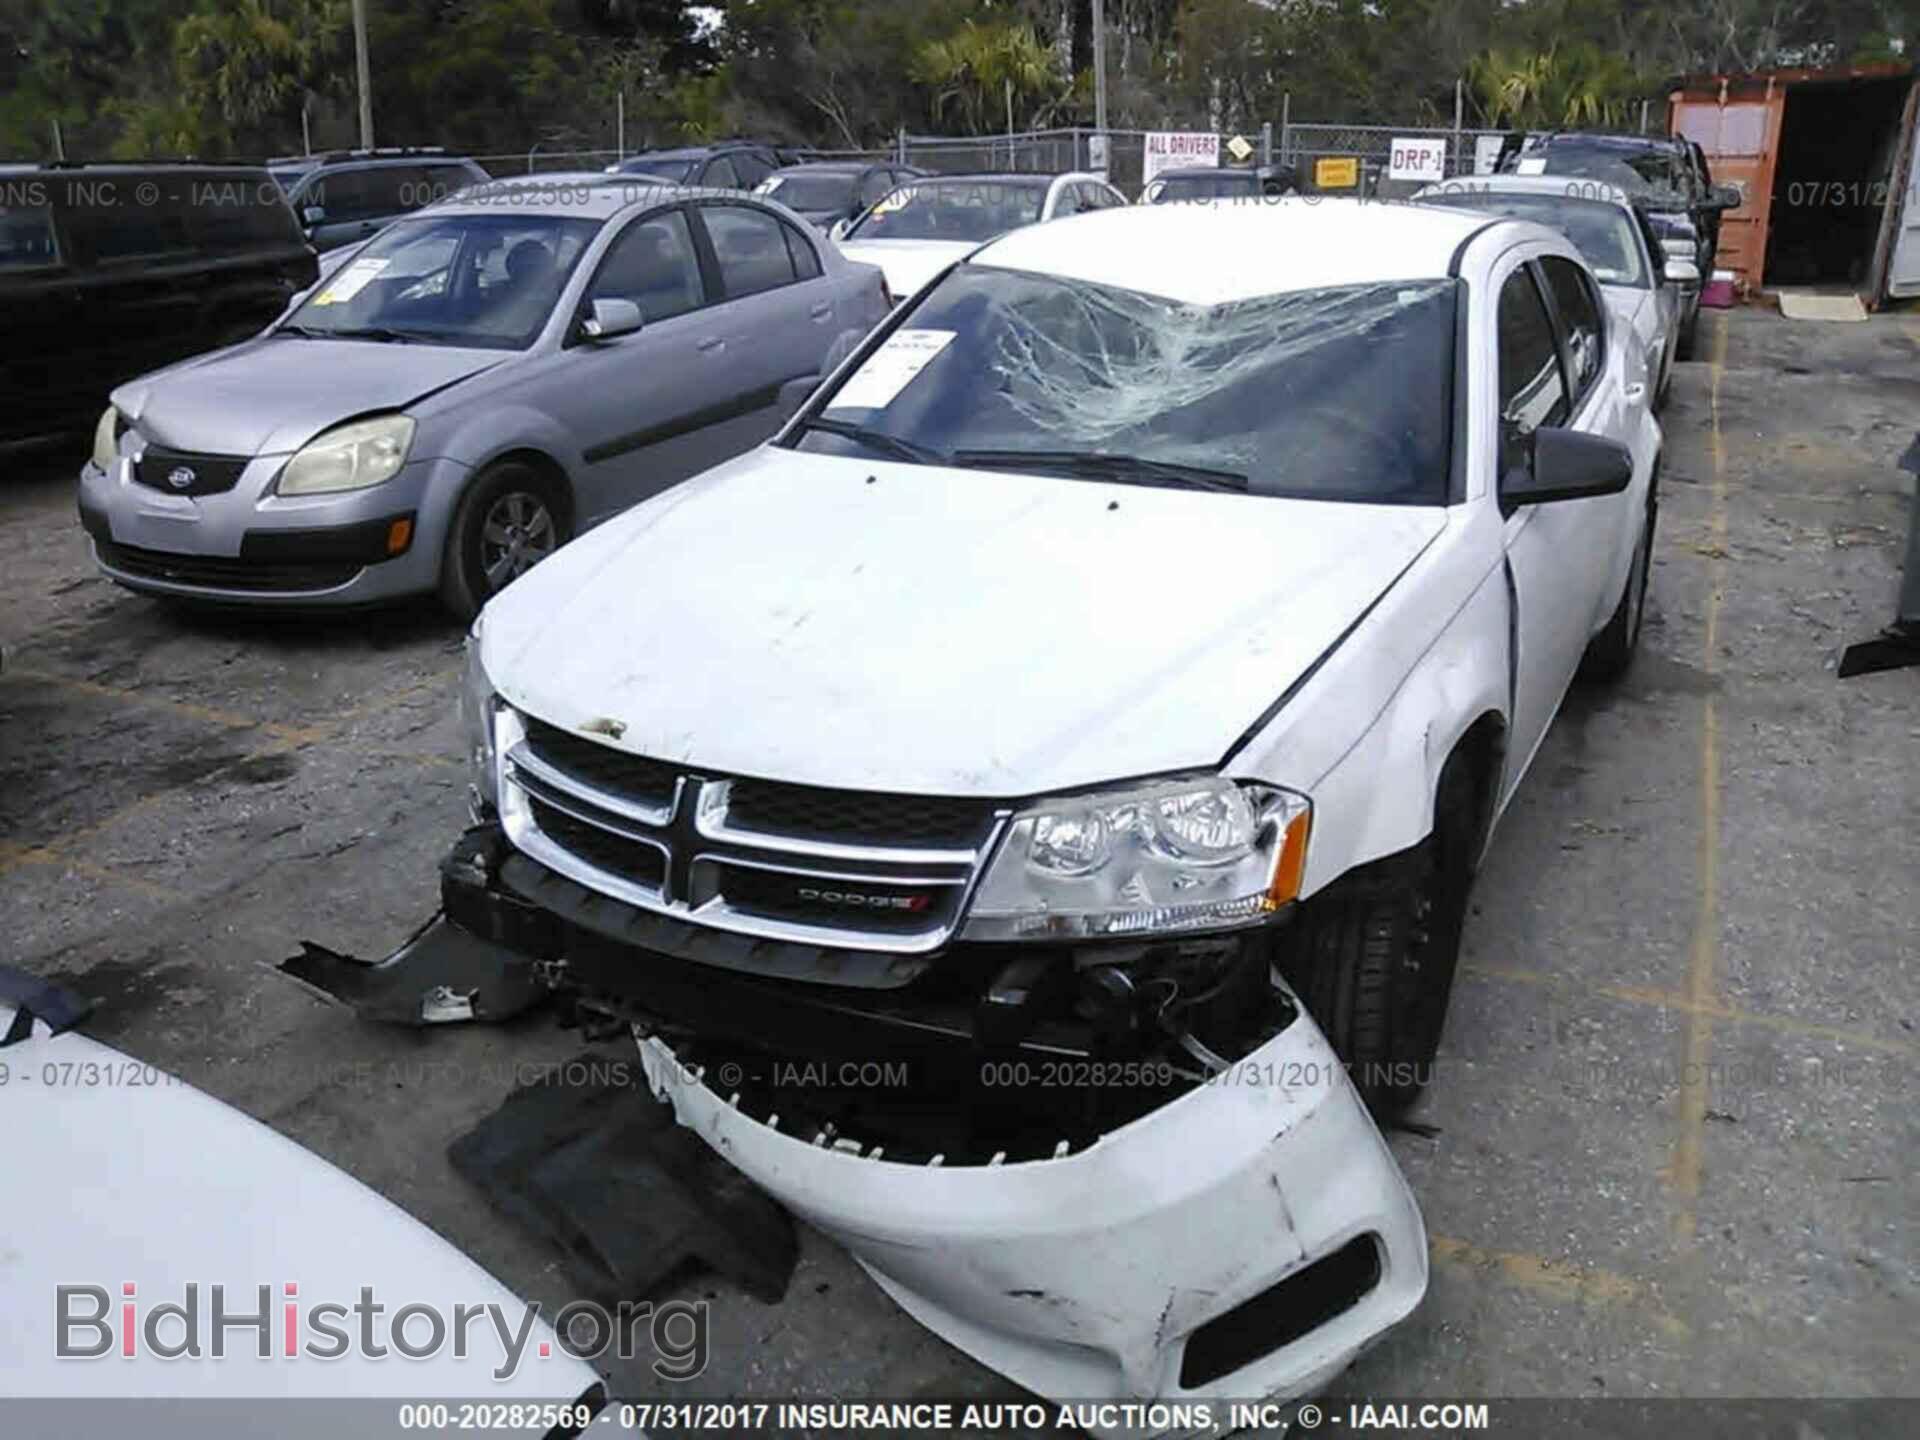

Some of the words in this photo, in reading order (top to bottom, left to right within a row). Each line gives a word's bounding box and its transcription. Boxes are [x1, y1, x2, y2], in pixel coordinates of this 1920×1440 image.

[1149, 135, 1167, 155] ALL
[1170, 135, 1217, 155] DRIVERS
[798, 887, 914, 909] DODGE
